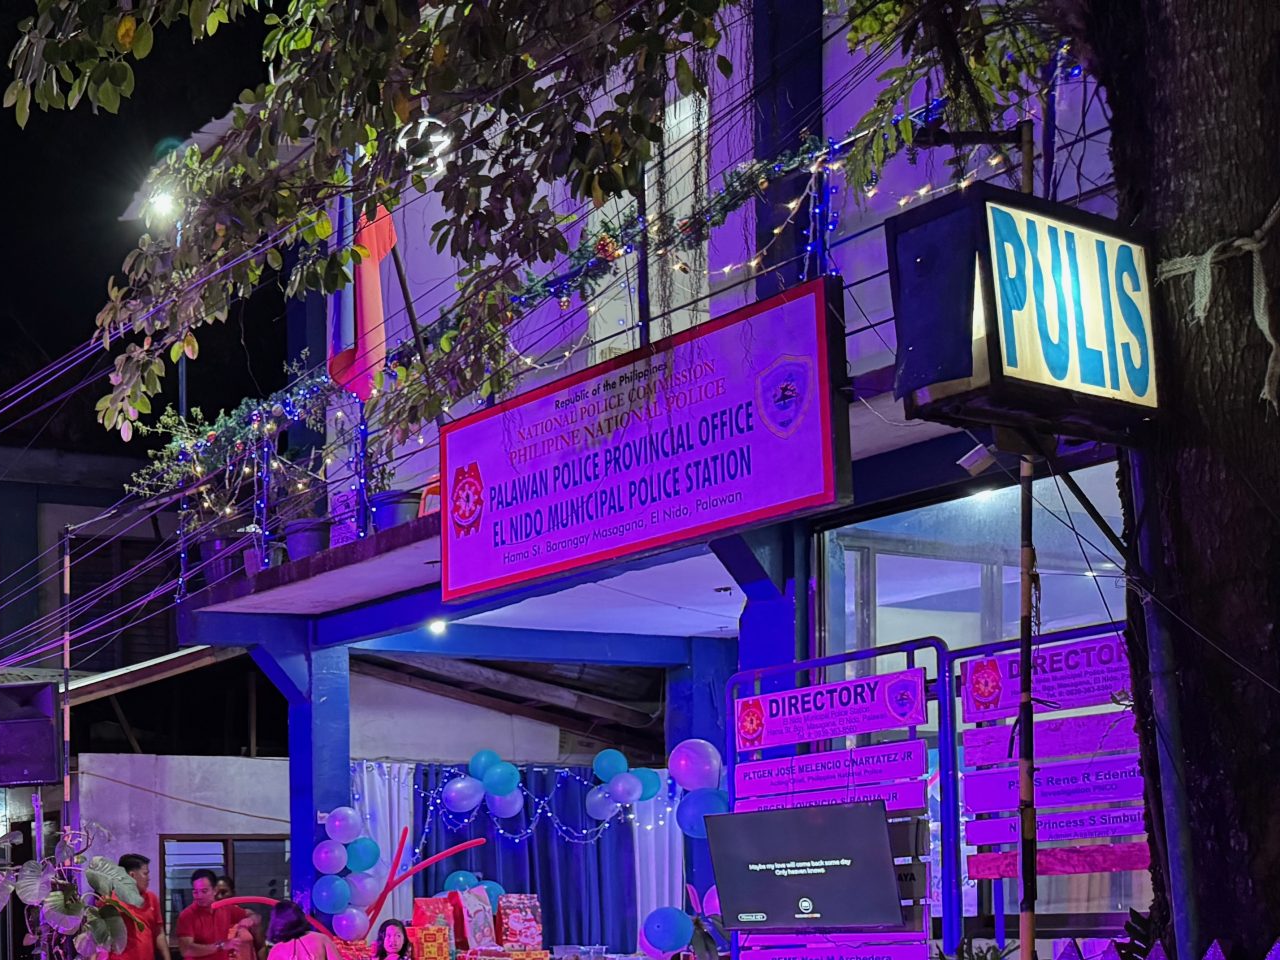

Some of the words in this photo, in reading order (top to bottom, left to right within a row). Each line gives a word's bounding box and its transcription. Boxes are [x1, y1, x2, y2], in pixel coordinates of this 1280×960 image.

[990, 206, 1150, 398] PULIS
[517, 411, 578, 443] NATIONAL
[580, 393, 624, 420] POLICE
[628, 359, 716, 403] COMMISSION
[554, 389, 589, 410] Republic
[592, 384, 602, 398] of
[603, 379, 617, 392] the
[619, 362, 668, 387] Philippines
[583, 402, 664, 440] NATIONAL
[665, 377, 727, 413] POLICE
[489, 468, 549, 512] PALAWAN
[553, 453, 599, 493] POLICE
[605, 427, 694, 478] PROVINCIAL
[698, 401, 755, 447] OFFICE
[493, 521, 506, 548] EL
[509, 508, 544, 544] NIDO
[548, 483, 625, 532] MUNICIPAL
[629, 467, 681, 510] POLICE
[685, 445, 752, 494] STATION
[503, 551, 530, 565] Hama
[532, 544, 543, 557] St.
[546, 533, 591, 554] Barangay
[592, 518, 648, 541] Masagana,
[650, 511, 660, 525] El
[663, 504, 693, 520] Nido,
[695, 490, 743, 510] Palawan
[1007, 643, 1128, 680] DRECTO
[768, 681, 879, 718] DIRECTORY
[743, 769, 773, 781] PLTGEN
[775, 765, 796, 776] JOSE
[798, 759, 842, 774] MELENCIO
[843, 758, 850, 768] C
[851, 752, 898, 768] NARTATEZ
[900, 750, 913, 761] JR
[1046, 775, 1078, 787] Rene
[1082, 772, 1091, 783] R
[885, 791, 898, 803] JR
[1035, 817, 1084, 830] Princess
[1089, 815, 1096, 826] S
[1100, 811, 1141, 824] Simbul
[748, 863, 766, 871] Maybe
[840, 858, 852, 866] day
[774, 868, 788, 877] Only
[898, 872, 917, 882] AYA
